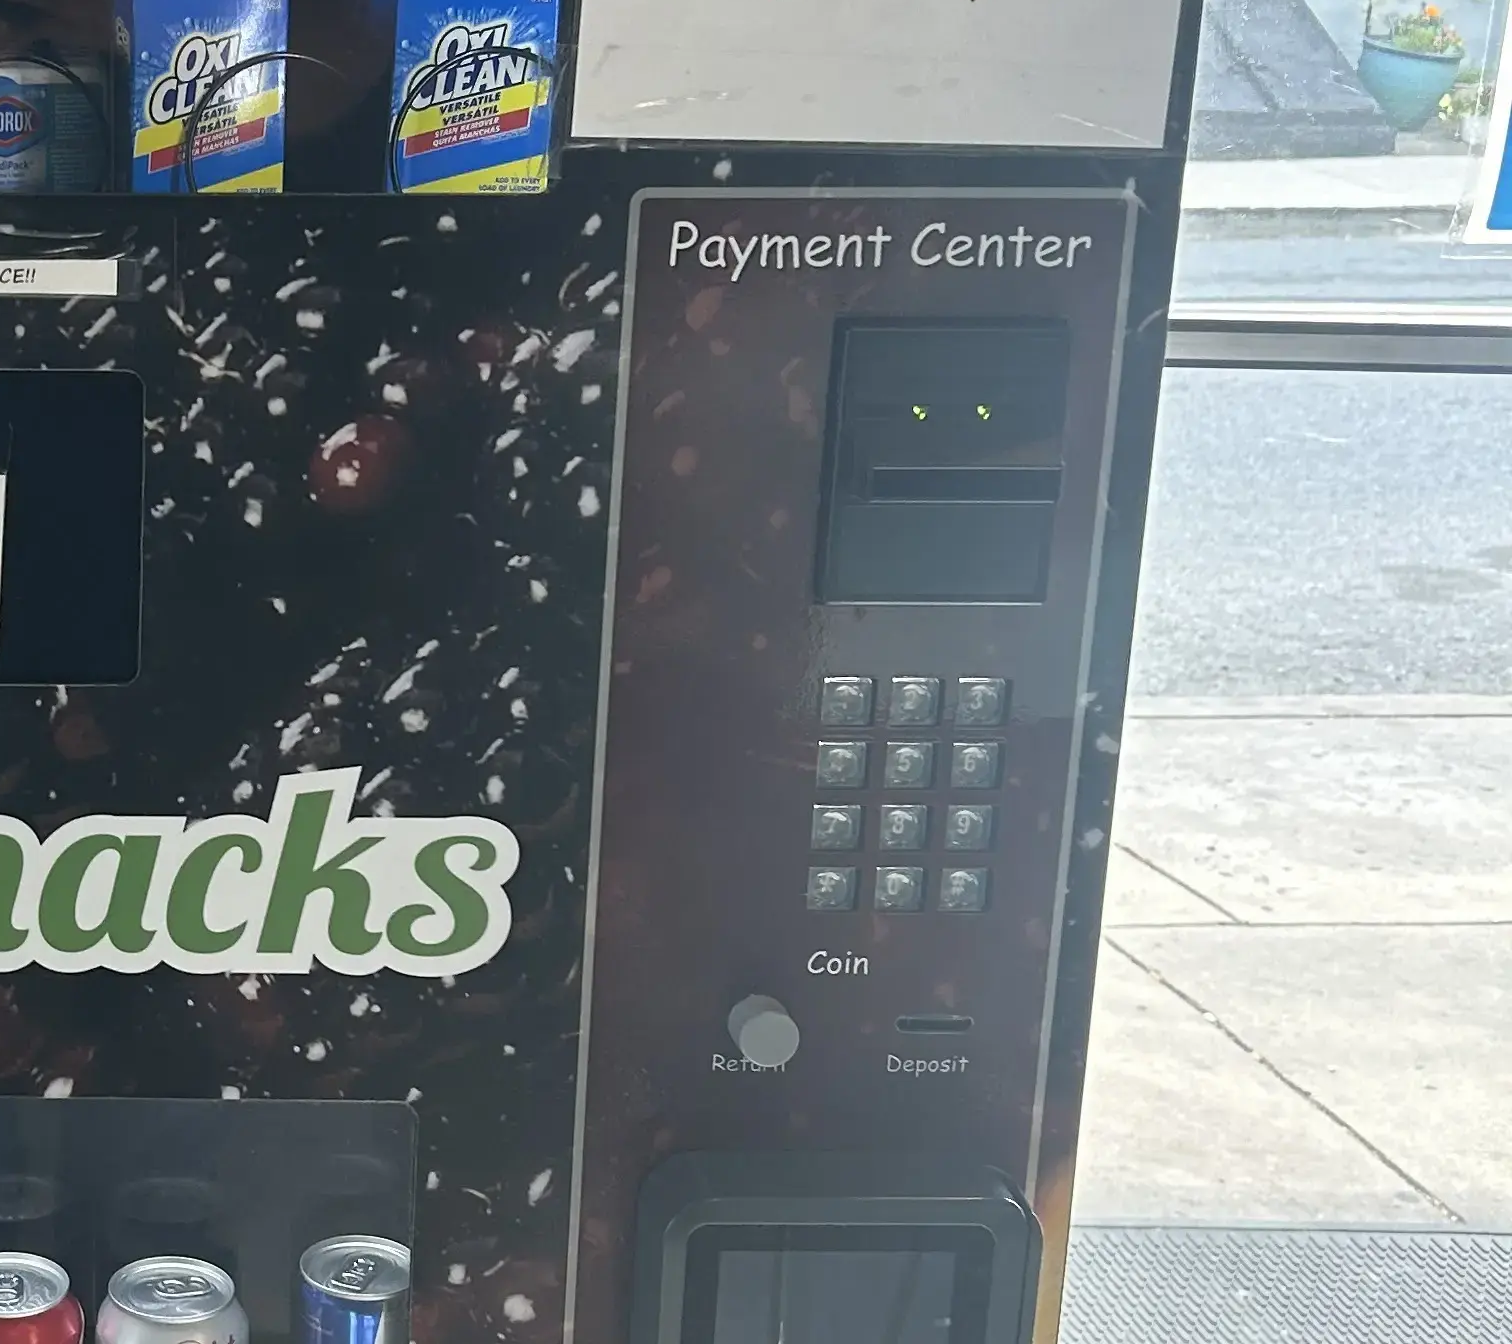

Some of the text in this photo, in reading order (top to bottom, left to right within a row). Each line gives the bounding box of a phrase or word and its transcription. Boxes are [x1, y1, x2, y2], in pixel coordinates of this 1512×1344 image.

[437, 24, 508, 66] OXI
[175, 35, 241, 83] OXI
[149, 62, 265, 124] CLEAN
[409, 55, 528, 110] CLEAN
[439, 91, 501, 115] VERSATILE
[442, 105, 500, 126] VERSÁTIL
[434, 116, 500, 139] STAIN REMOVER
[459, 125, 501, 141] MANCHAS
[669, 220, 1093, 284] Payment Center
[806, 950, 871, 976] Coin
[886, 1054, 970, 1075] Deposit
